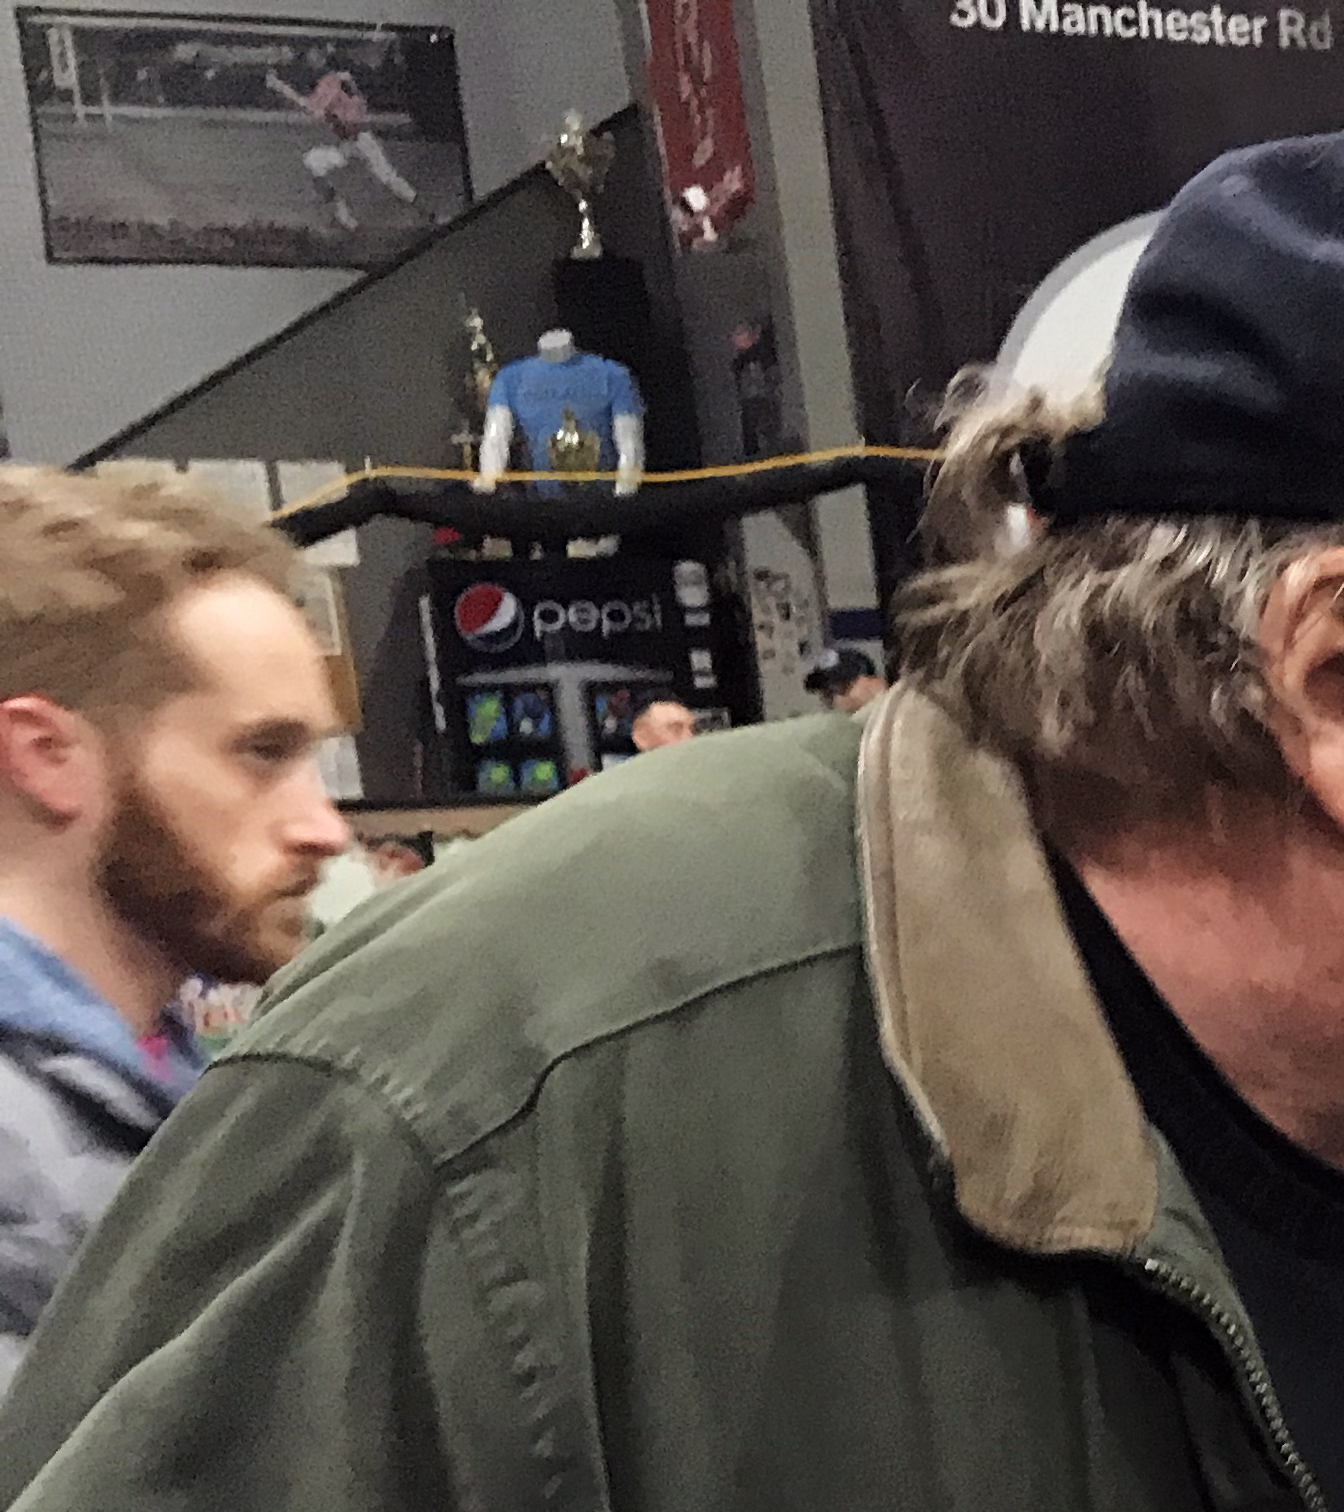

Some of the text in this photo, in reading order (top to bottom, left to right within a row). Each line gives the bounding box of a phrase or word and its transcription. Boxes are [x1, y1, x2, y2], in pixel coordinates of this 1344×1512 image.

[1019, 0, 1267, 47] Manchester
[1278, 7, 1333, 51] Rd
[532, 596, 663, 641] pepsi
